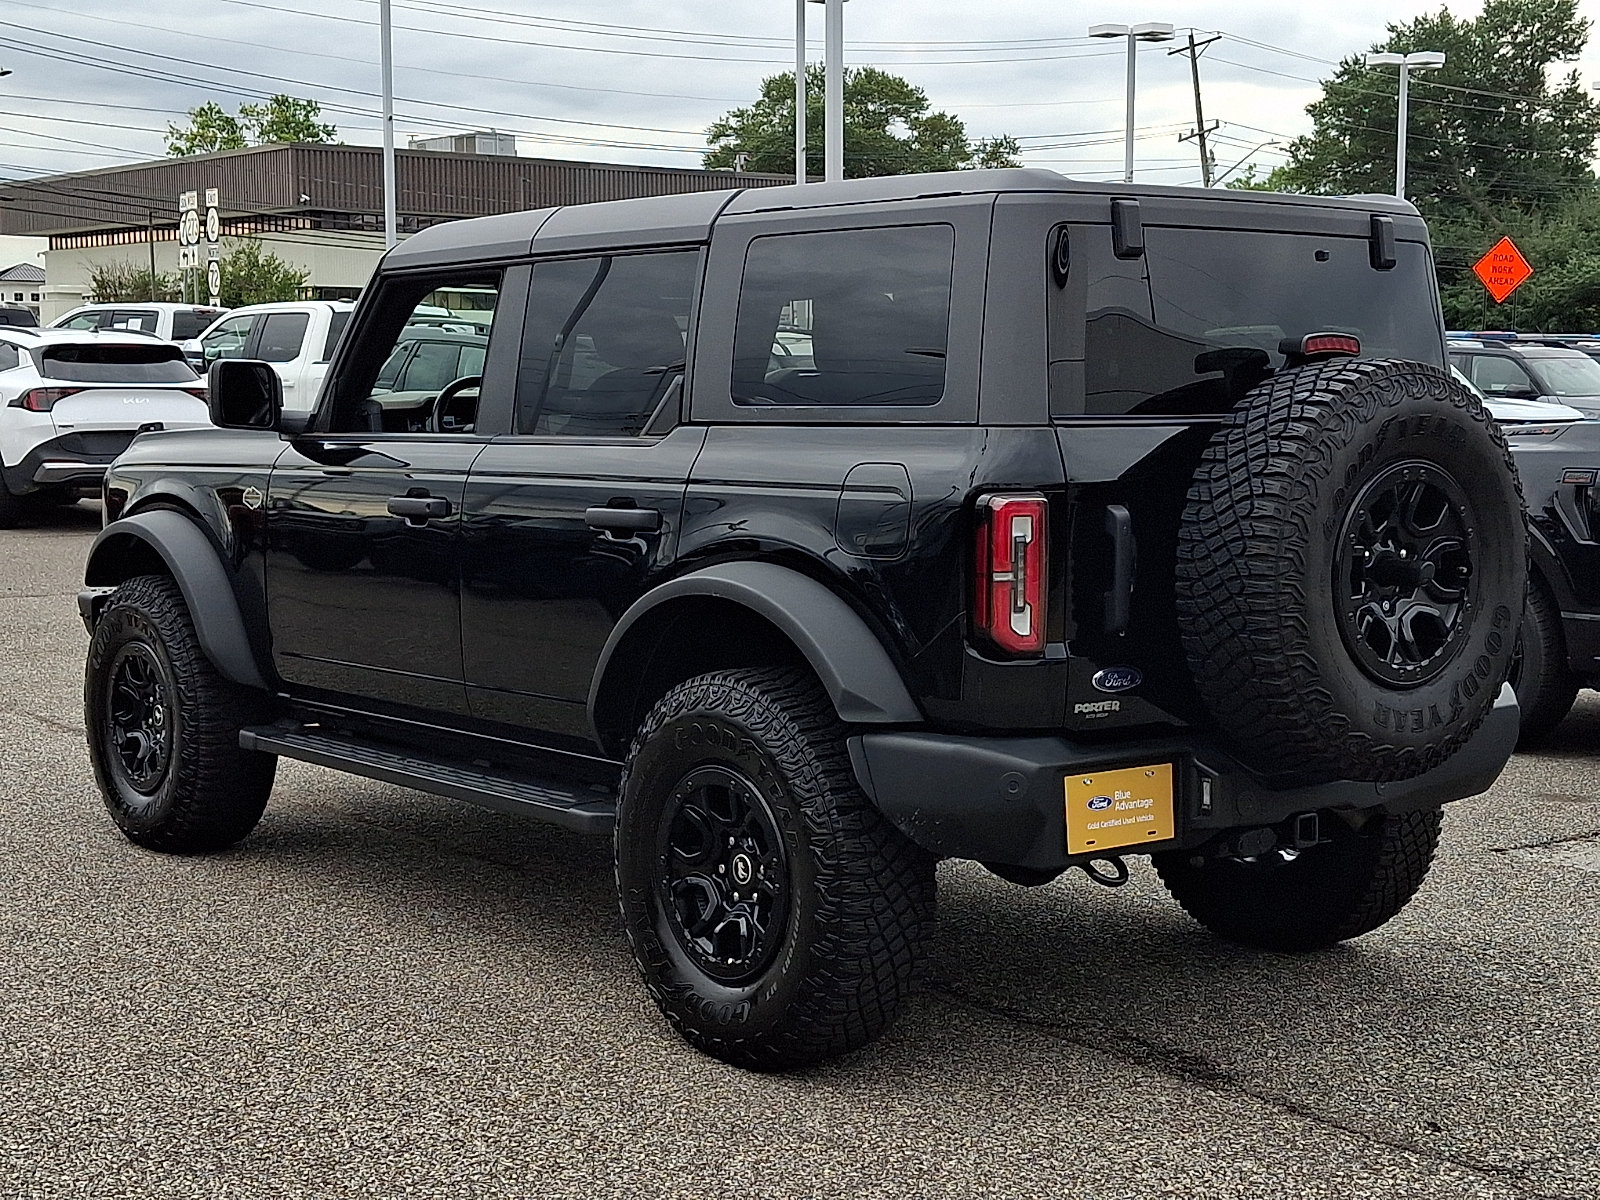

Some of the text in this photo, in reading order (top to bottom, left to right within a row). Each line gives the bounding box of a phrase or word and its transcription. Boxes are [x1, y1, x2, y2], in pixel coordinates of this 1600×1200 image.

[210, 215, 216, 235] 2
[1492, 253, 1515, 263] ROAD
[1491, 265, 1513, 275] WORK
[210, 269, 219, 288] 72
[1488, 276, 1515, 286] AHEAD
[1074, 700, 1120, 713] PORTER
[1115, 790, 1131, 800] Blue
[1115, 798, 1154, 811] Advantage
[1122, 817, 1136, 826] Used
